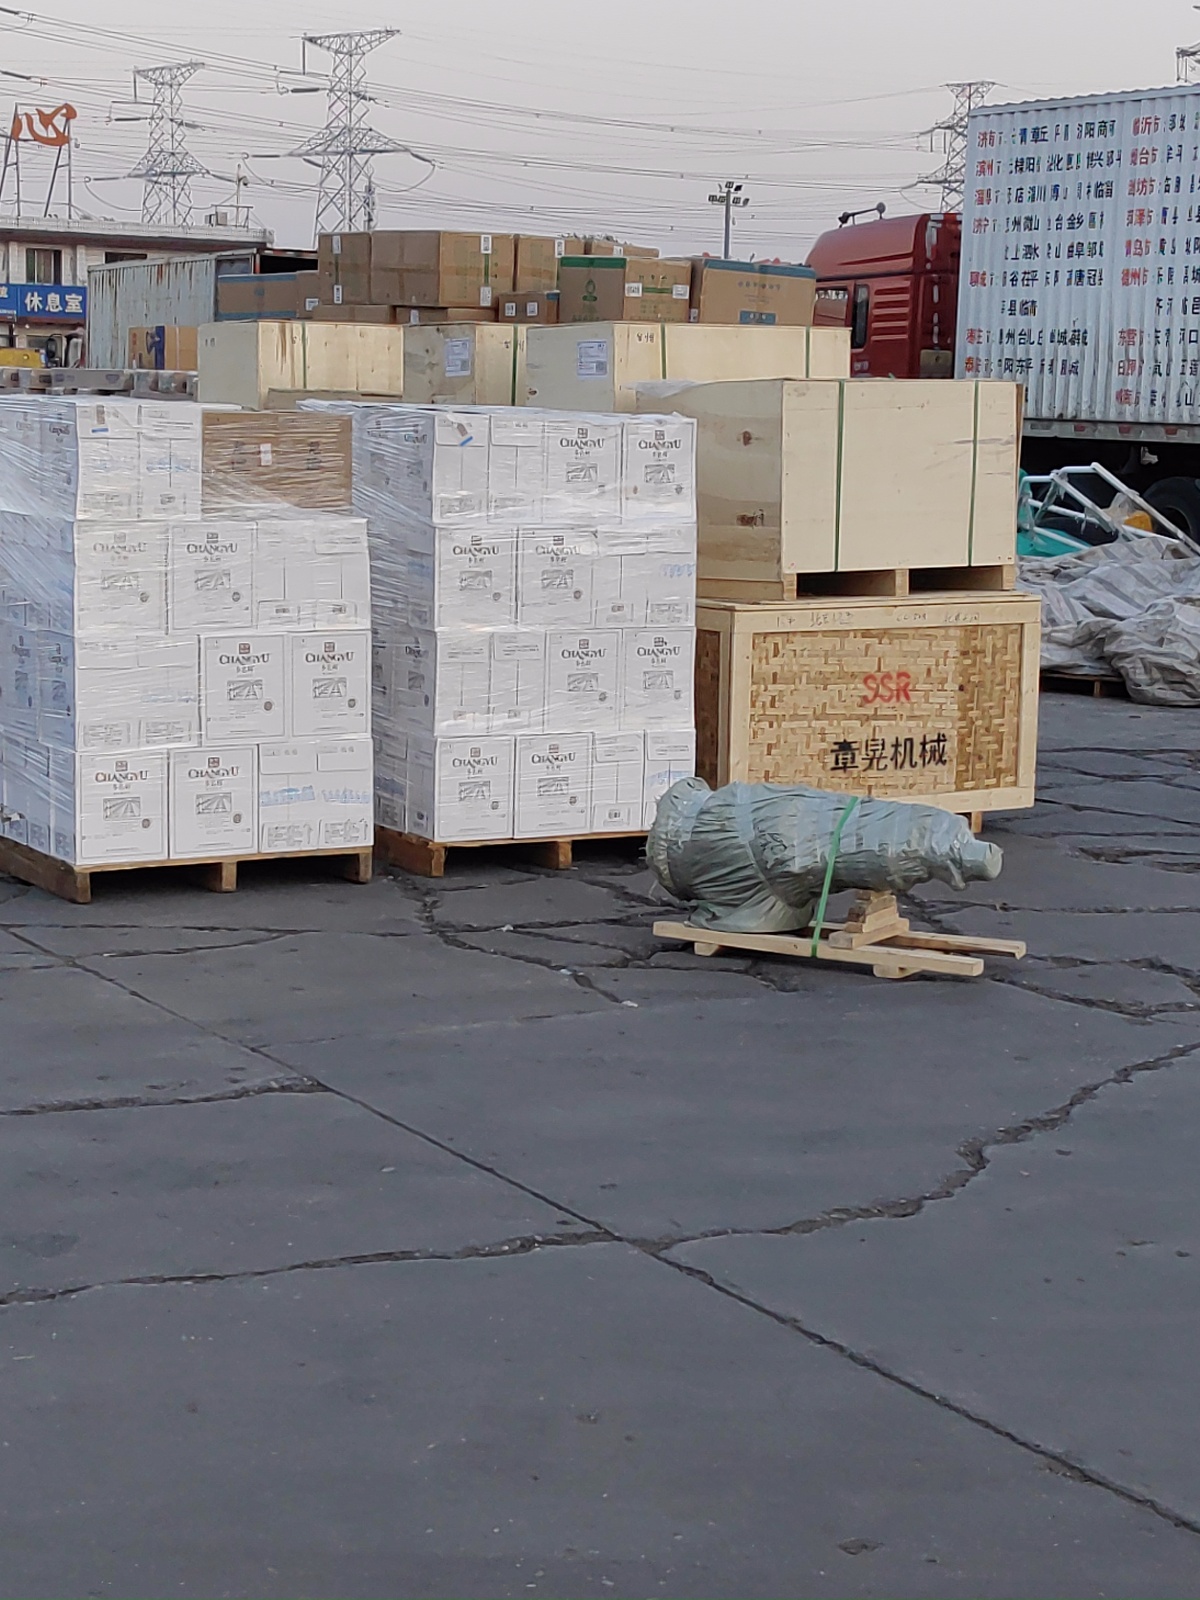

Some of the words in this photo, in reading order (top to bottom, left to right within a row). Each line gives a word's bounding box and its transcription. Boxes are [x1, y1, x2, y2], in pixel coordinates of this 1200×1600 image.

[24, 291, 83, 313] 休息室
[219, 653, 272, 666] CHANGYU
[305, 651, 355, 665] CHANGYU
[561, 649, 607, 661] CHANGYU
[637, 647, 681, 659] CHANGYU
[863, 672, 911, 704] SSR
[452, 757, 498, 769] CHANGYU
[531, 753, 577, 765] CHANGYU
[95, 771, 148, 784] CHANGYU
[188, 766, 239, 780] CHANGYU
